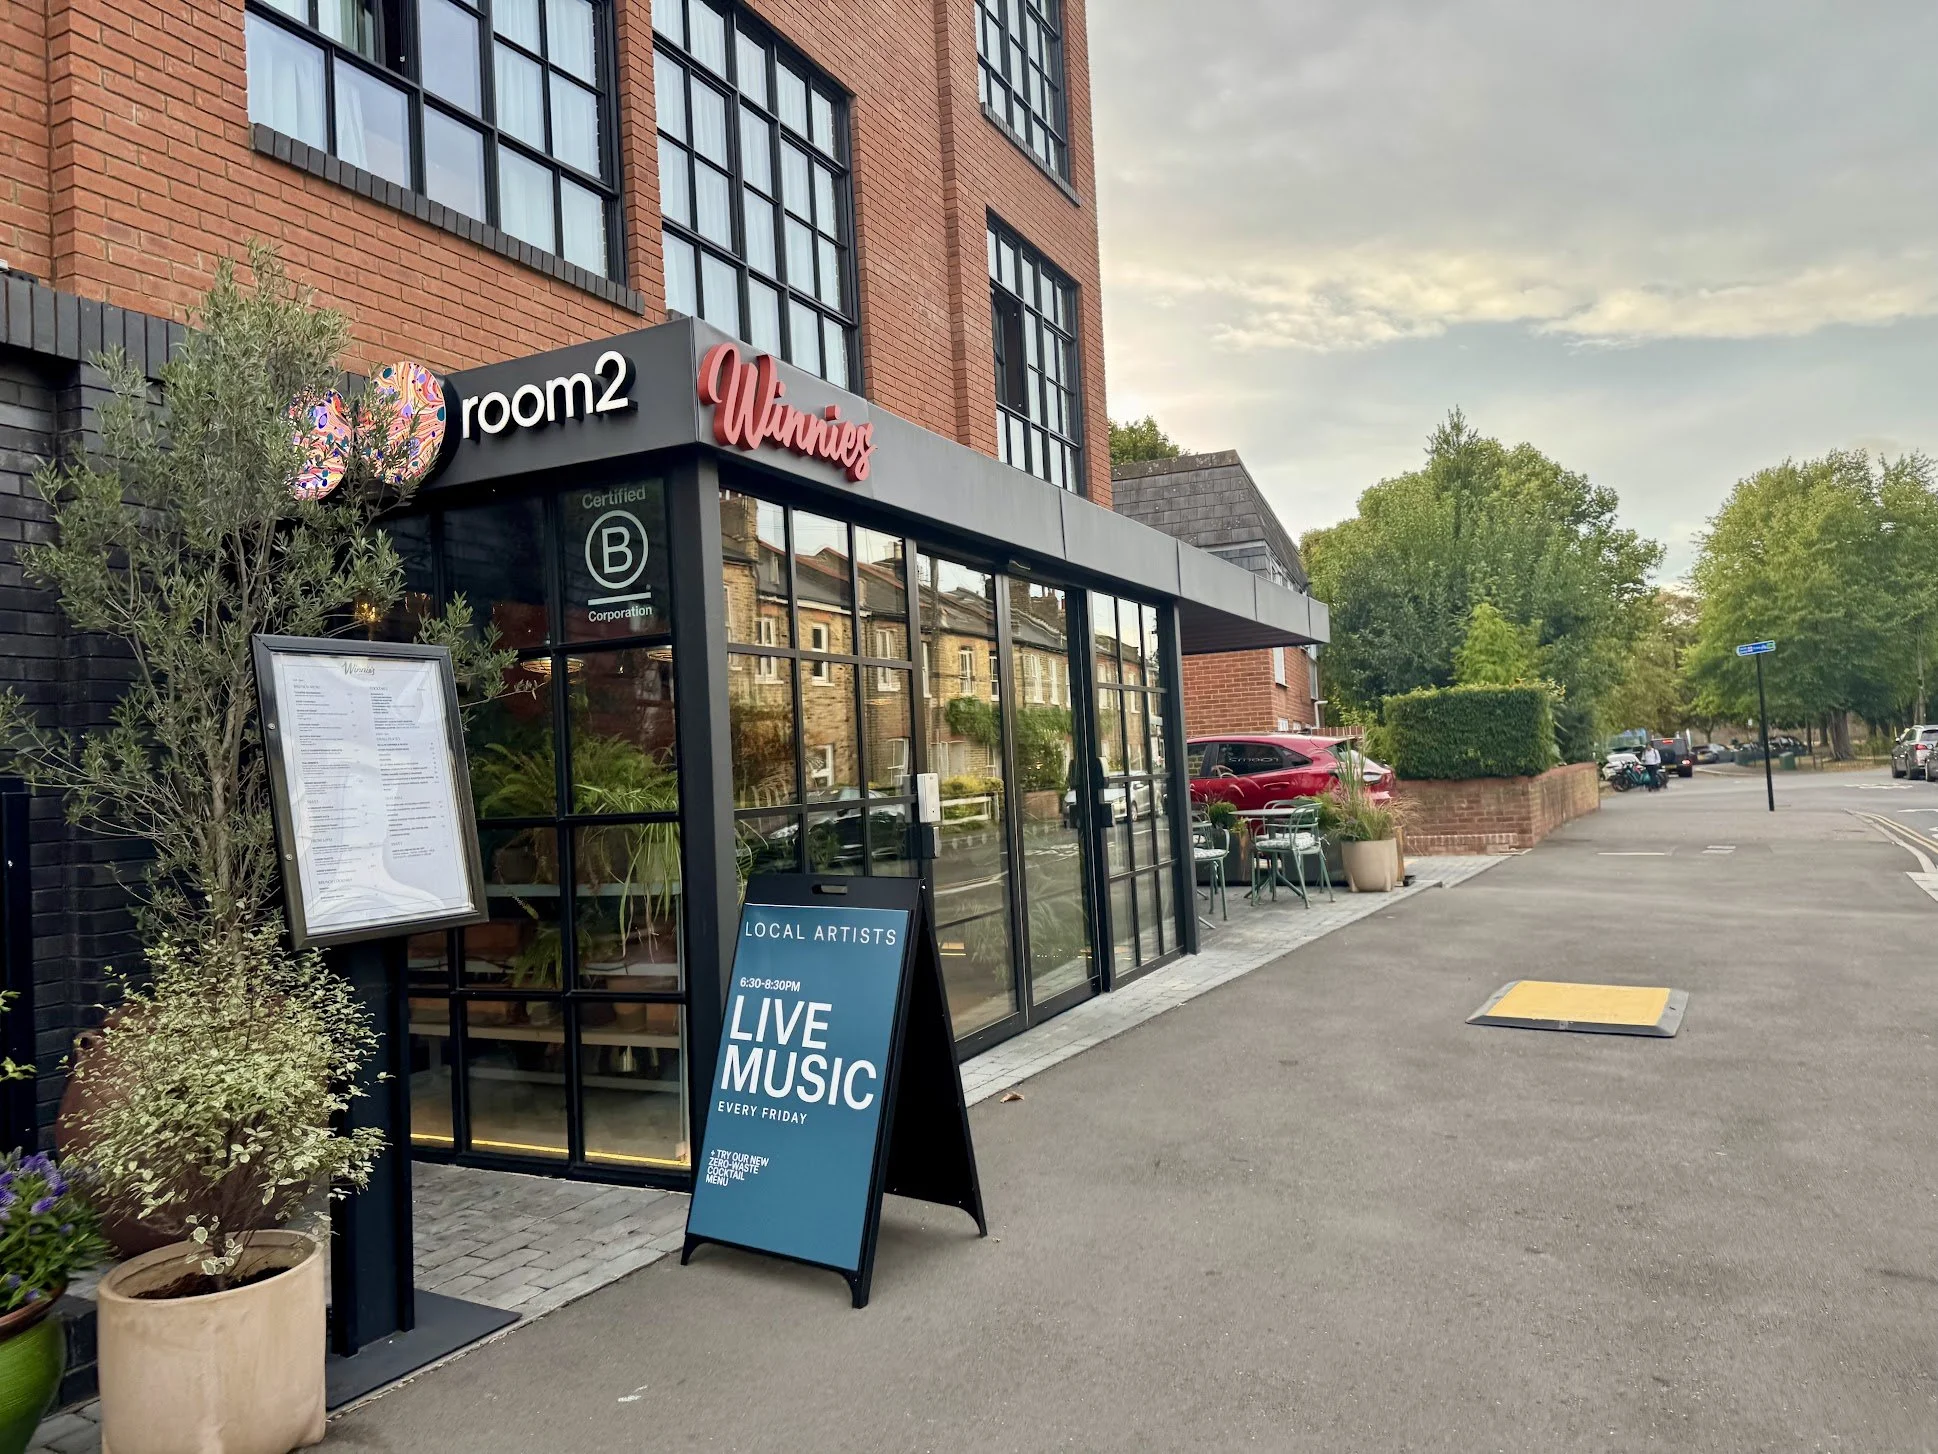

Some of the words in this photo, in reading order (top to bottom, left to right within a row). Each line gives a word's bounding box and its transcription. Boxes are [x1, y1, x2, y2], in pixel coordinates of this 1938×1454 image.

[462, 350, 629, 439] room2
[699, 342, 878, 482] Winnies
[582, 484, 646, 509] Certified
[601, 526, 633, 574] B
[588, 606, 653, 622] Corporation
[745, 921, 805, 940] LOCAL
[814, 925, 897, 946] ARTISTS
[740, 976, 801, 992] 6:30-8:30PM
[730, 994, 832, 1050] LIVE
[720, 1044, 877, 1111] MUSIC
[717, 1100, 757, 1117] EVERY
[762, 1107, 808, 1125] FRIDAY
[708, 1156, 760, 1174] ZERO-WASTE
[716, 1149, 732, 1160] TRY
[732, 1152, 749, 1163] OUR
[750, 1155, 769, 1167] NEW
[705, 1174, 729, 1187] MENU
[707, 1166, 745, 1180] COCKTAIL
